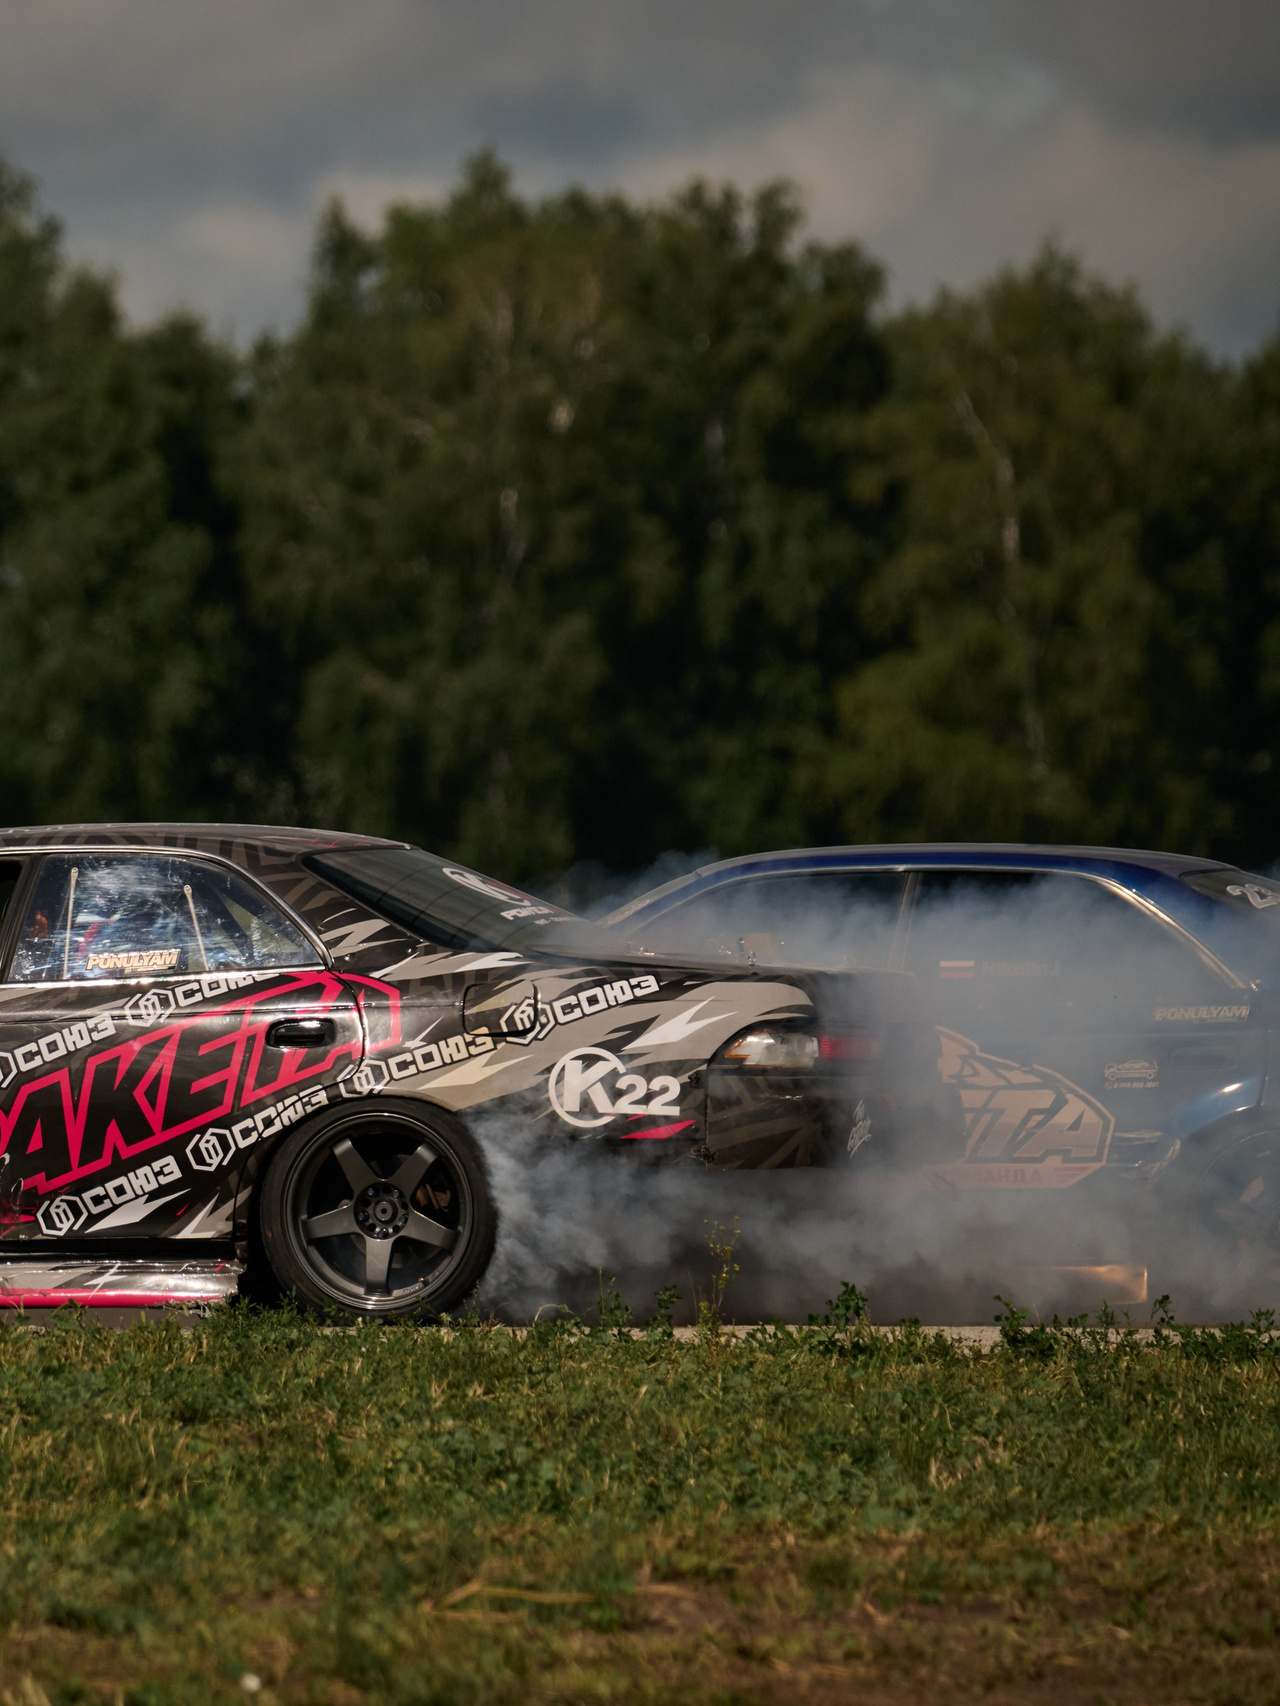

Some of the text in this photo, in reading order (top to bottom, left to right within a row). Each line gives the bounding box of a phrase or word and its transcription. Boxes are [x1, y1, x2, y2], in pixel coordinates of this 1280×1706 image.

[86, 949, 179, 971] PONULYAM
[1155, 1004, 1248, 1021] PONULYAM
[549, 1047, 681, 1128] K22
